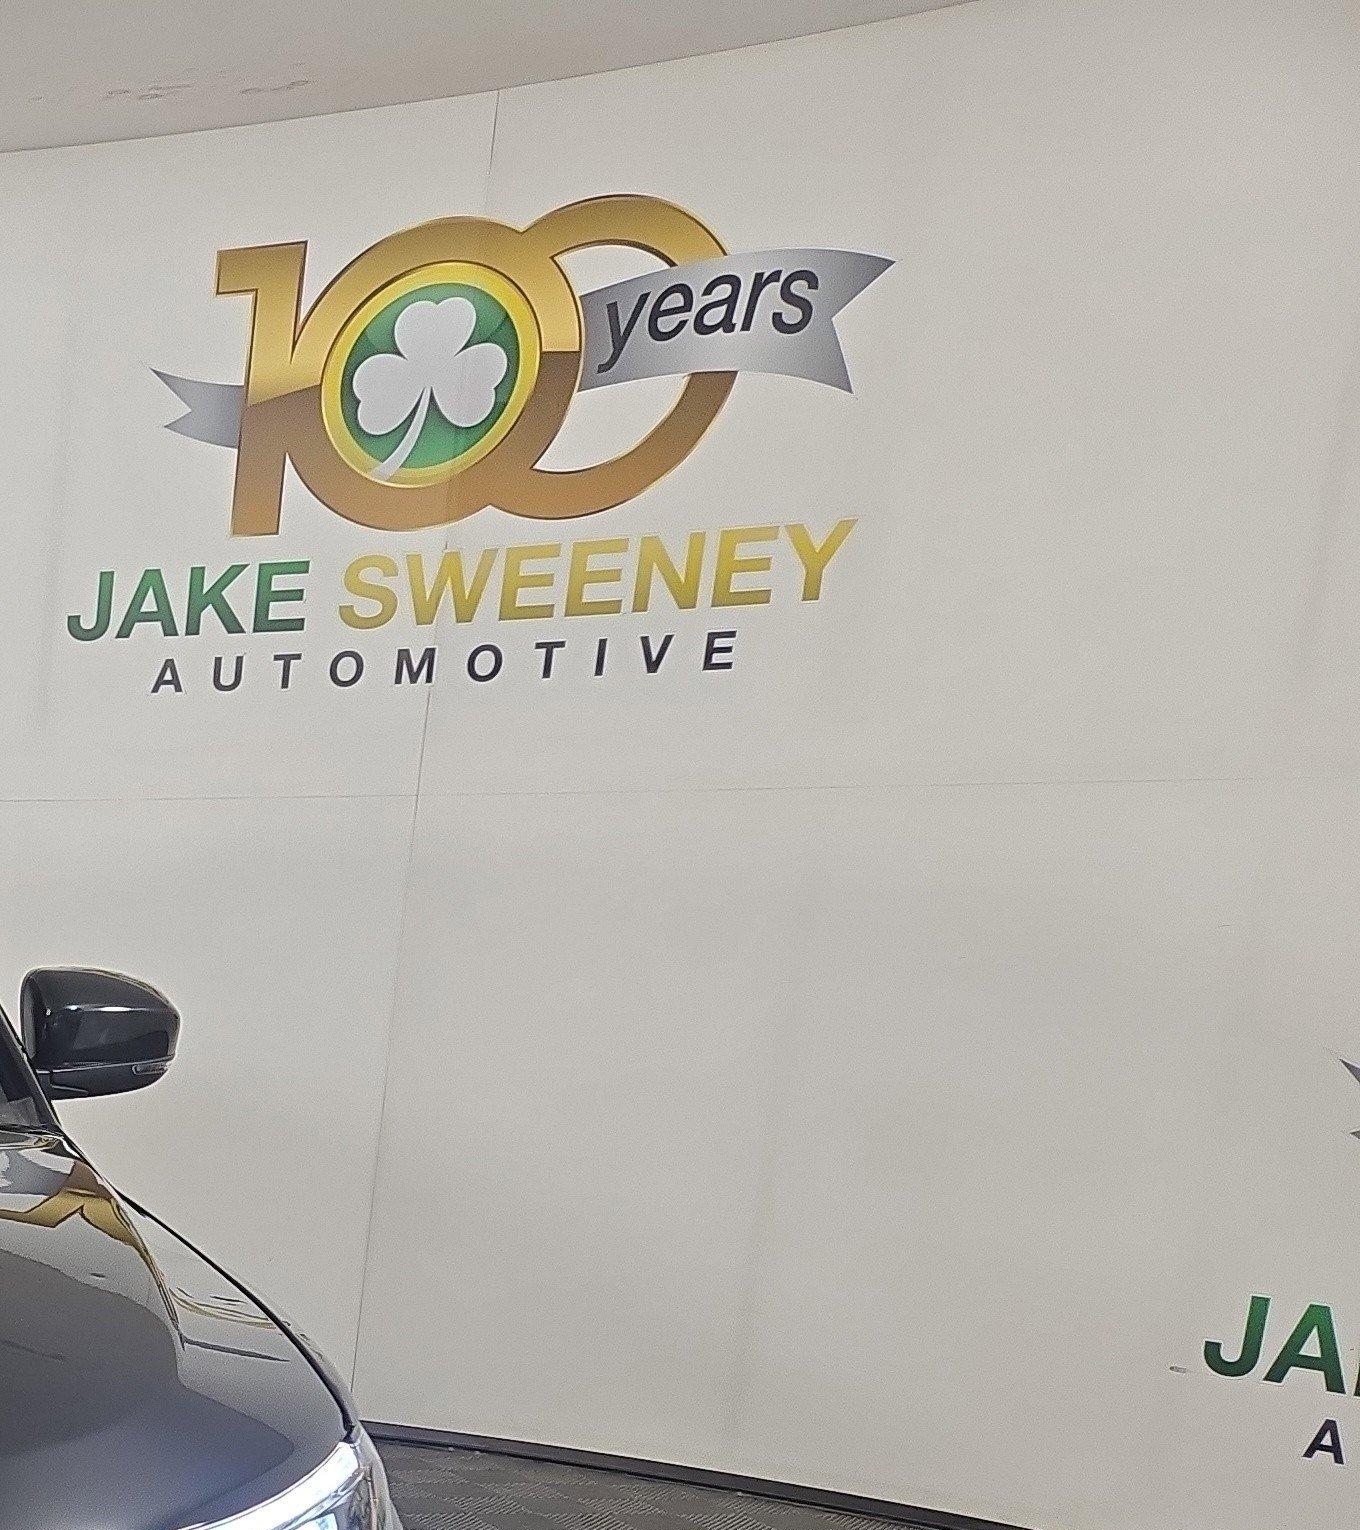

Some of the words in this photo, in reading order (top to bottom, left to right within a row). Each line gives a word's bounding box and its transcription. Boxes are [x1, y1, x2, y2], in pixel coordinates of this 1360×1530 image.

[215, 193, 736, 537] 100
[596, 267, 820, 374] years
[66, 559, 312, 642] JAKE
[338, 518, 860, 631] SWEENEY
[150, 629, 740, 694] AUTOMOTIVE
[1203, 1295, 1360, 1398] JA
